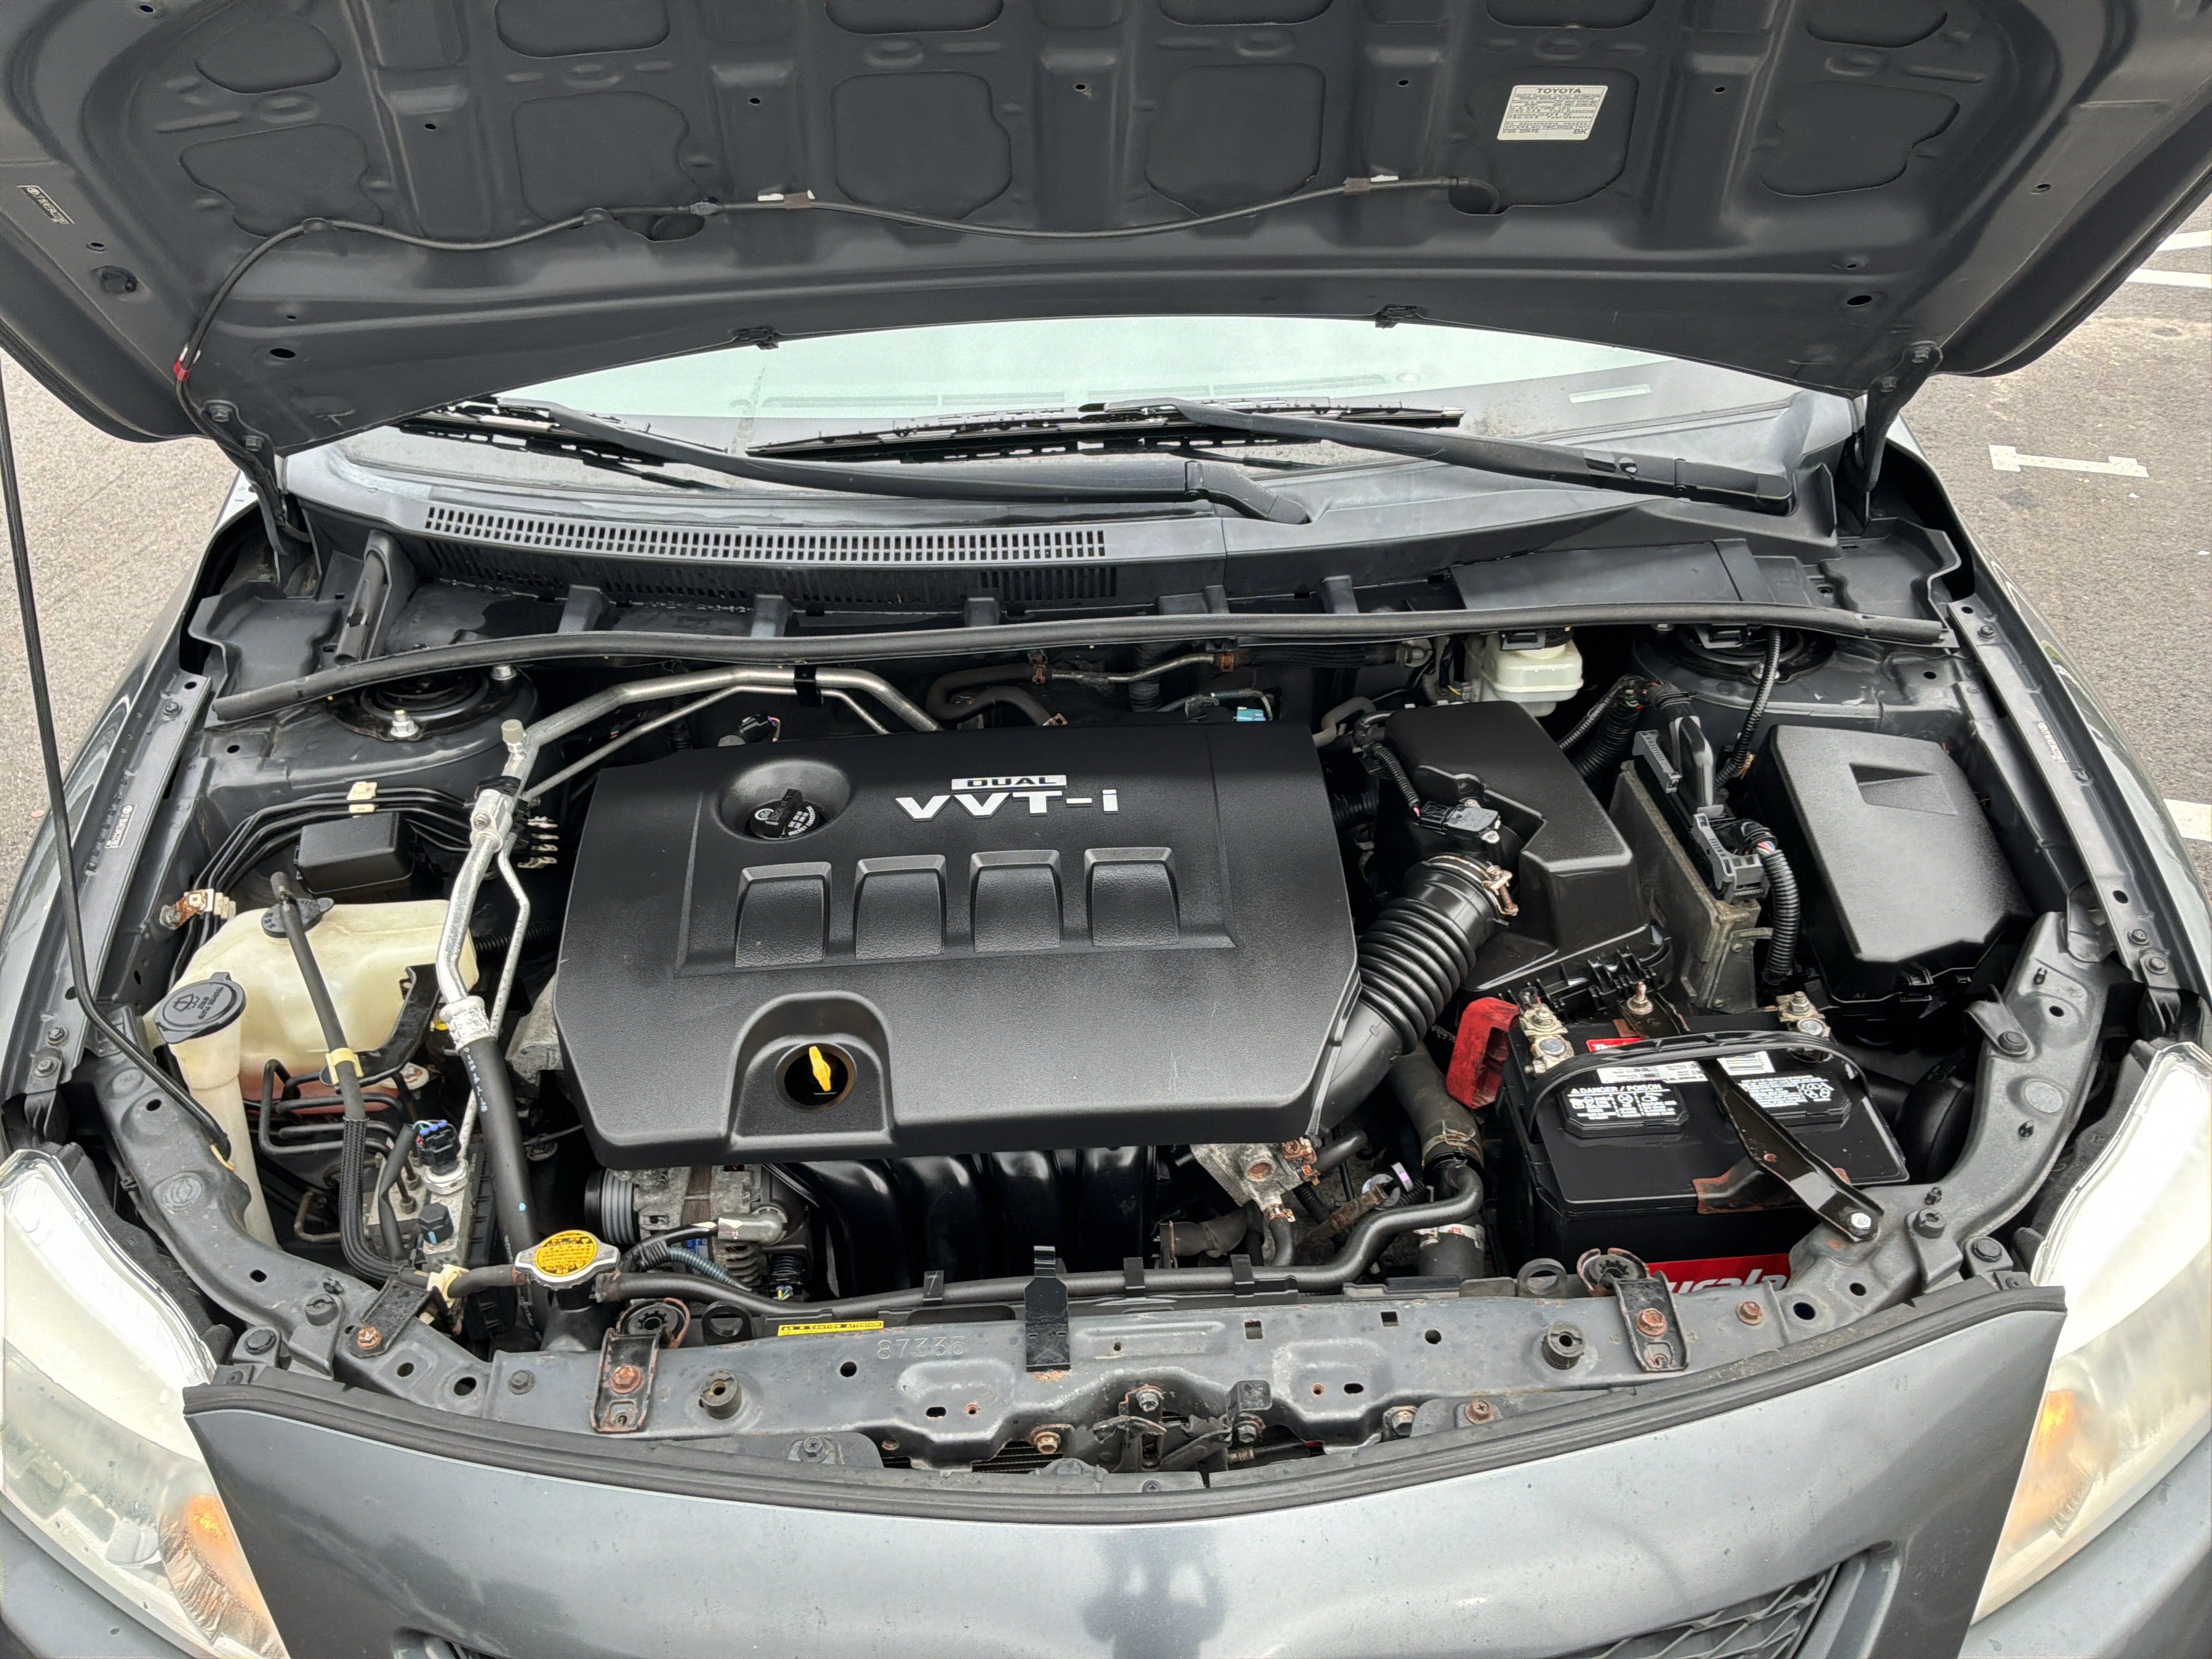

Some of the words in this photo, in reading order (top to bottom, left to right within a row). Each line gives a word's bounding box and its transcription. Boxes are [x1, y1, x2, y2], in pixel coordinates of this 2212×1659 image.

[967, 777, 1058, 787] DUAL
[895, 789, 1119, 821] VVT-i
[1579, 1086, 1618, 1094] DANGER
